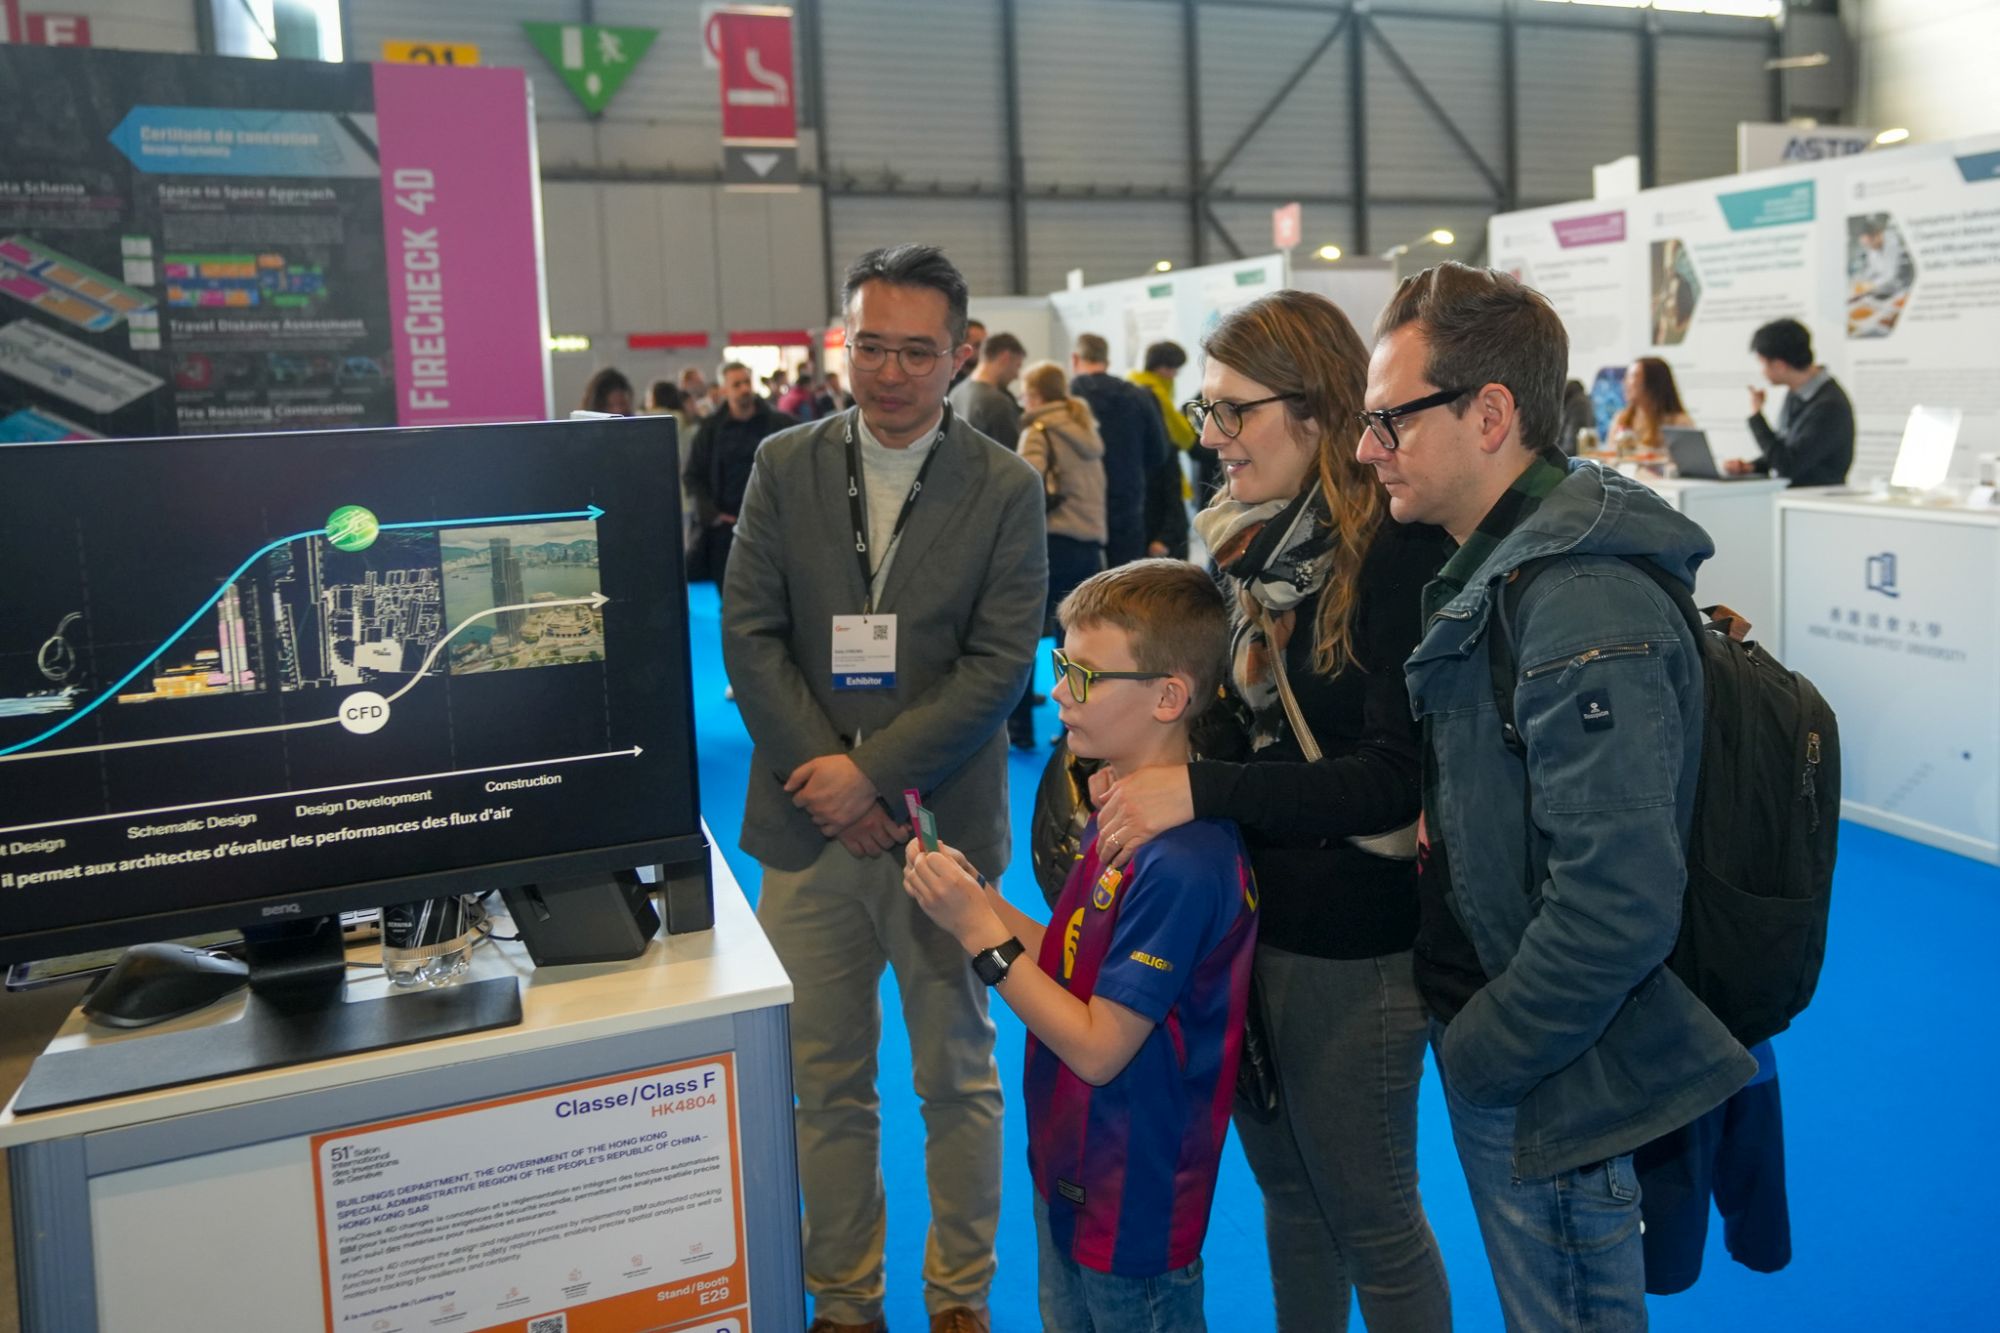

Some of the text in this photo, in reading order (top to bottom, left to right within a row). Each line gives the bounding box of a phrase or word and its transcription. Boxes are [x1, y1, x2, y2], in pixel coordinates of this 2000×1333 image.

[158, 183, 200, 199] Space
[204, 186, 220, 198] to
[224, 184, 265, 201] Space
[394, 169, 449, 409] FIRECHECK 4D
[170, 319, 215, 332] Travel
[218, 319, 279, 331] Distance
[177, 406, 204, 419] Fire
[275, 402, 365, 417] Construction
[846, 677, 882, 685] Exhibitor
[346, 706, 382, 720] CFD
[485, 774, 562, 793] Construction
[296, 790, 433, 817] Design Development
[127, 813, 257, 839] Schematic Design
[1, 872, 15, 888] il
[17, 866, 83, 889] permet
[84, 862, 117, 876] aux
[118, 848, 211, 871] architectes
[290, 833, 314, 847] les
[316, 821, 420, 847] performances
[422, 816, 448, 830] des
[450, 812, 477, 826] flux
[480, 807, 513, 822] d'air
[10, 837, 66, 855] Design
[555, 1071, 714, 1117] Classe/Class F
[651, 1093, 715, 1116] HK4804
[331, 1152, 389, 1169] International
[353, 1147, 379, 1156] Salon
[332, 1159, 398, 1177] des Inventions
[336, 1130, 667, 1208] BUILDINGS DEPARTMENT, THE GOVERNMENT OF THE HONG KONG
[337, 1204, 382, 1219] SPECIAL
[386, 1183, 474, 1208] ADMINISTRATIVE
[478, 1174, 517, 1188] REGION
[519, 1169, 532, 1179] OF
[535, 1165, 554, 1175] THE
[606, 1144, 653, 1160] REPUBLIC
[655, 1140, 668, 1150] OF
[670, 1134, 700, 1146] CHINA
[338, 1229, 382, 1243] FireCheck
[398, 1218, 434, 1230] changes
[444, 1205, 490, 1219] conception
[634, 1166, 668, 1177] fonctions
[340, 1244, 356, 1254] BIM
[357, 1240, 377, 1251] pour
[451, 1215, 492, 1227] exigences
[574, 1186, 616, 1201] permettant
[633, 1176, 662, 1187] analyse
[663, 1170, 692, 1180] spatiale
[337, 1204, 429, 1230] HONG KONG SAR
[341, 1266, 383, 1280] FireCheck
[386, 1261, 398, 1269] 4D
[399, 1254, 435, 1266] changes
[451, 1243, 477, 1255] design
[479, 1238, 495, 1247] and
[496, 1230, 536, 1243] regulatory
[537, 1222, 567, 1234] process
[580, 1208, 631, 1223] implementing
[632, 1203, 647, 1212] BIM
[647, 1194, 688, 1208] automated
[688, 1188, 721, 1199] checking
[657, 1276, 728, 1300] Stand/Booth
[699, 1286, 729, 1304] E29
